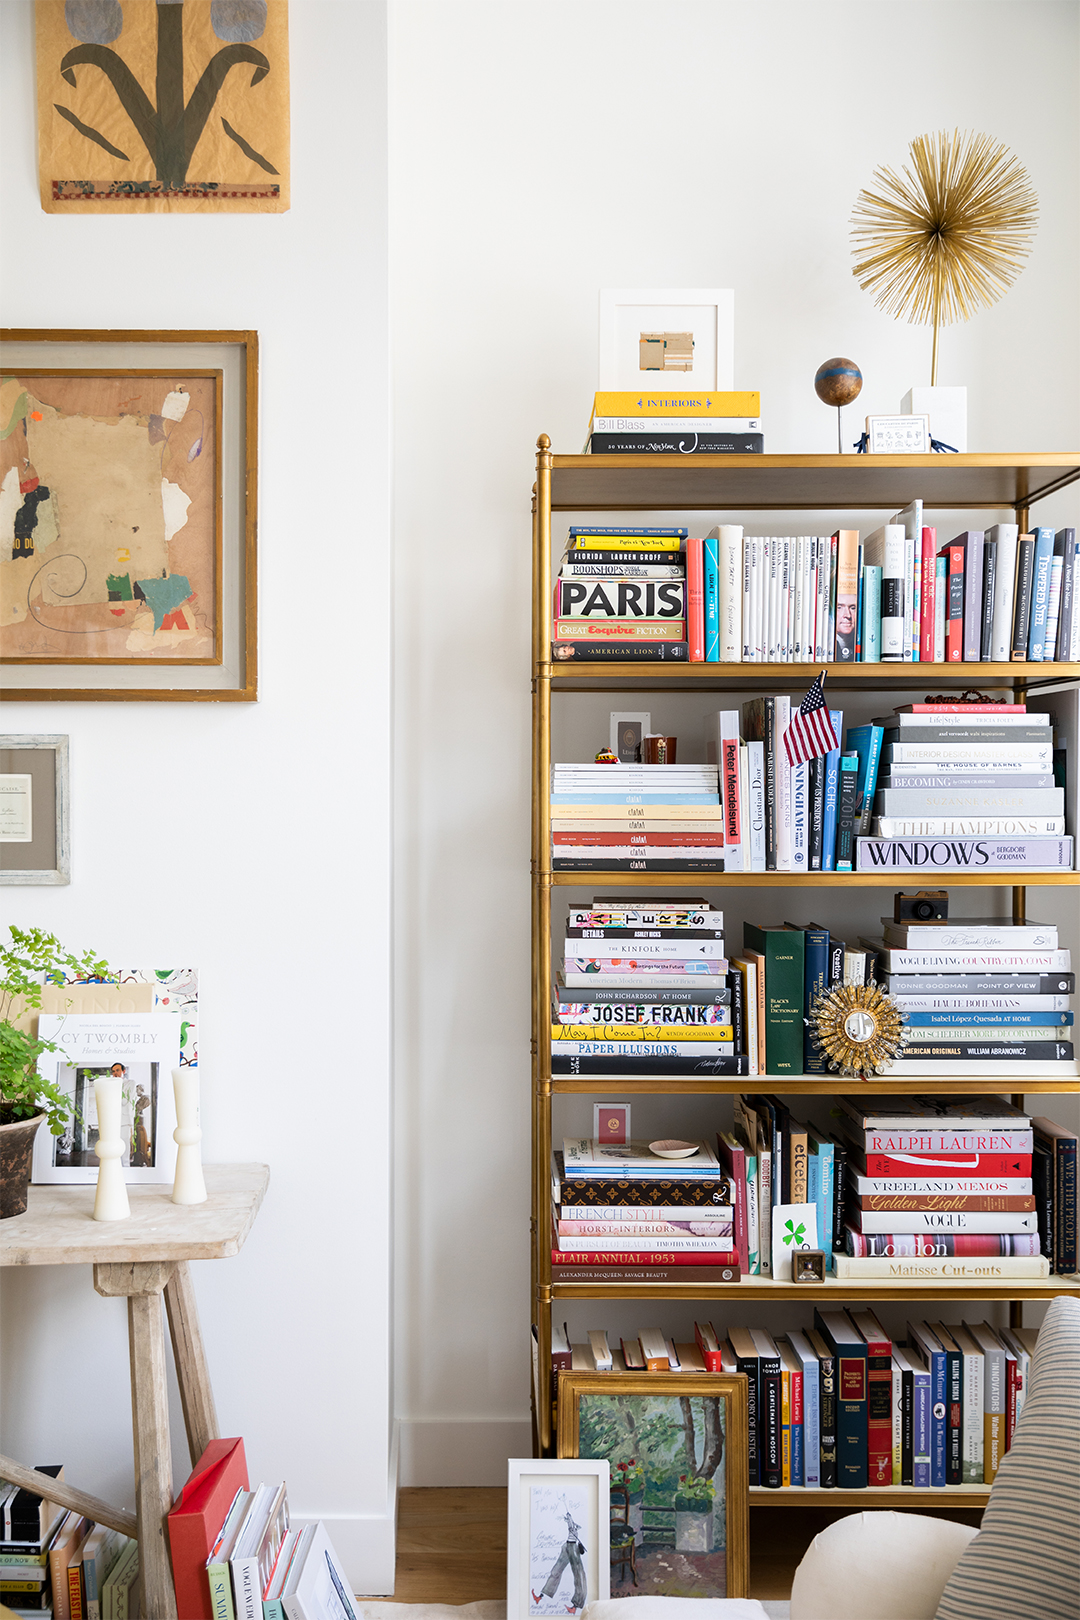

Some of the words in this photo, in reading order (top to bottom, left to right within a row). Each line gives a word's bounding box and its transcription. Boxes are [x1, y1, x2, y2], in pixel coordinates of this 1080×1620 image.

[647, 399, 702, 408] INTERIORS
[598, 419, 615, 430] Bill
[617, 419, 645, 430] Blass
[639, 553, 661, 561] GROFF
[572, 565, 624, 574] BOOKSHOPS
[1022, 545, 1030, 589] GREENLIGHTS
[1037, 554, 1050, 604] TEMPERED
[562, 583, 682, 617] PARIS
[1034, 604, 1047, 627] STEEL
[559, 625, 587, 635] GREAT
[588, 625, 635, 636] Esquire
[636, 627, 667, 635] FICTION
[726, 744, 737, 772] Peter
[906, 750, 942, 758] INTERIOR
[942, 750, 972, 758] DESIGN
[973, 750, 1001, 758] MASTER
[1004, 750, 1033, 758] CLASS
[752, 768, 762, 790] Dior
[827, 769, 837, 785] SO
[894, 777, 951, 787] BECOMING
[727, 774, 738, 837] Mendelsund
[826, 786, 836, 812] CHIC
[926, 798, 979, 806] SUZANNE
[983, 798, 1024, 806] KASLER
[752, 792, 764, 831] Christian
[840, 796, 854, 828] 2015
[899, 822, 935, 835] THE
[942, 821, 1038, 834] HAMPTONS
[867, 842, 990, 865] WINDOWS
[996, 853, 1026, 861] GOODMAN
[582, 930, 605, 939] DETAILS
[621, 945, 661, 953] KINFOLK
[832, 948, 842, 979] Creative
[899, 957, 929, 966] VOGUE
[929, 957, 961, 966] LIVING
[962, 957, 1004, 966] COUNTRY,
[1004, 957, 1026, 966] CITY,
[1026, 957, 1053, 966] COAST
[595, 992, 613, 1000] JOHN
[933, 1000, 964, 1008] HAUTE
[965, 1000, 1021, 1008] BOHEMIANS
[592, 1007, 646, 1023] JOSEF
[652, 1007, 708, 1023] FRANK
[951, 1015, 1002, 1024] López-Quesada
[61, 1032, 81, 1044] CY
[84, 1032, 158, 1044] TWOMBLY
[559, 1025, 588, 1040] May
[588, 1026, 601, 1039] I
[603, 1025, 636, 1040] Come
[638, 1026, 662, 1039] In?
[908, 1030, 926, 1039] TOM
[926, 1030, 971, 1038] SCHEERER
[972, 1030, 997, 1038] MORE
[997, 1029, 1049, 1037] DECORATING
[81, 1046, 102, 1055] Homes
[105, 1046, 111, 1055] &
[113, 1046, 136, 1055] Studios
[578, 1044, 615, 1054] PAPER
[618, 1045, 678, 1054] ILLUSIONS
[902, 1047, 931, 1055] AMERICAN
[931, 1047, 961, 1055] ORIGINALS
[967, 1047, 990, 1055] WILLIAM
[990, 1047, 1027, 1055] ABRANOWICZ
[872, 1136, 933, 1150] RALPH
[939, 1136, 1013, 1150] LAUREN
[761, 1159, 770, 1188] GOODBYE
[822, 1155, 831, 1195] domino
[1065, 1161, 1075, 1178] WE
[872, 1182, 954, 1191] VREELAND
[956, 1182, 1009, 1191] MEMOS
[1065, 1181, 1075, 1205] THE
[868, 1194, 918, 1210] Golden
[918, 1195, 969, 1211] Light
[568, 1208, 623, 1220] FRENCH
[626, 1209, 665, 1221] STYLE
[923, 1214, 967, 1228] VOGUE
[579, 1225, 614, 1233] HORST
[622, 1225, 676, 1233] INTERIORS
[1065, 1208, 1075, 1253] PEOPLE
[869, 1237, 948, 1257] London
[555, 1253, 589, 1263] FLAIR
[592, 1253, 644, 1263] ANNUAL
[650, 1253, 675, 1264] 1953
[888, 1264, 938, 1276] Matisse
[941, 1263, 1002, 1276] Cut-outs
[991, 1362, 1000, 1412] INNOVATORS
[748, 1384, 756, 1416] THEORY
[749, 1419, 756, 1428] OF
[991, 1416, 1000, 1438] Walter
[991, 1439, 999, 1470] Isaacson
[69, 1571, 80, 1587] THE
[55, 1573, 63, 1616] BENEFICIARY
[70, 1588, 81, 1611] FEAST
